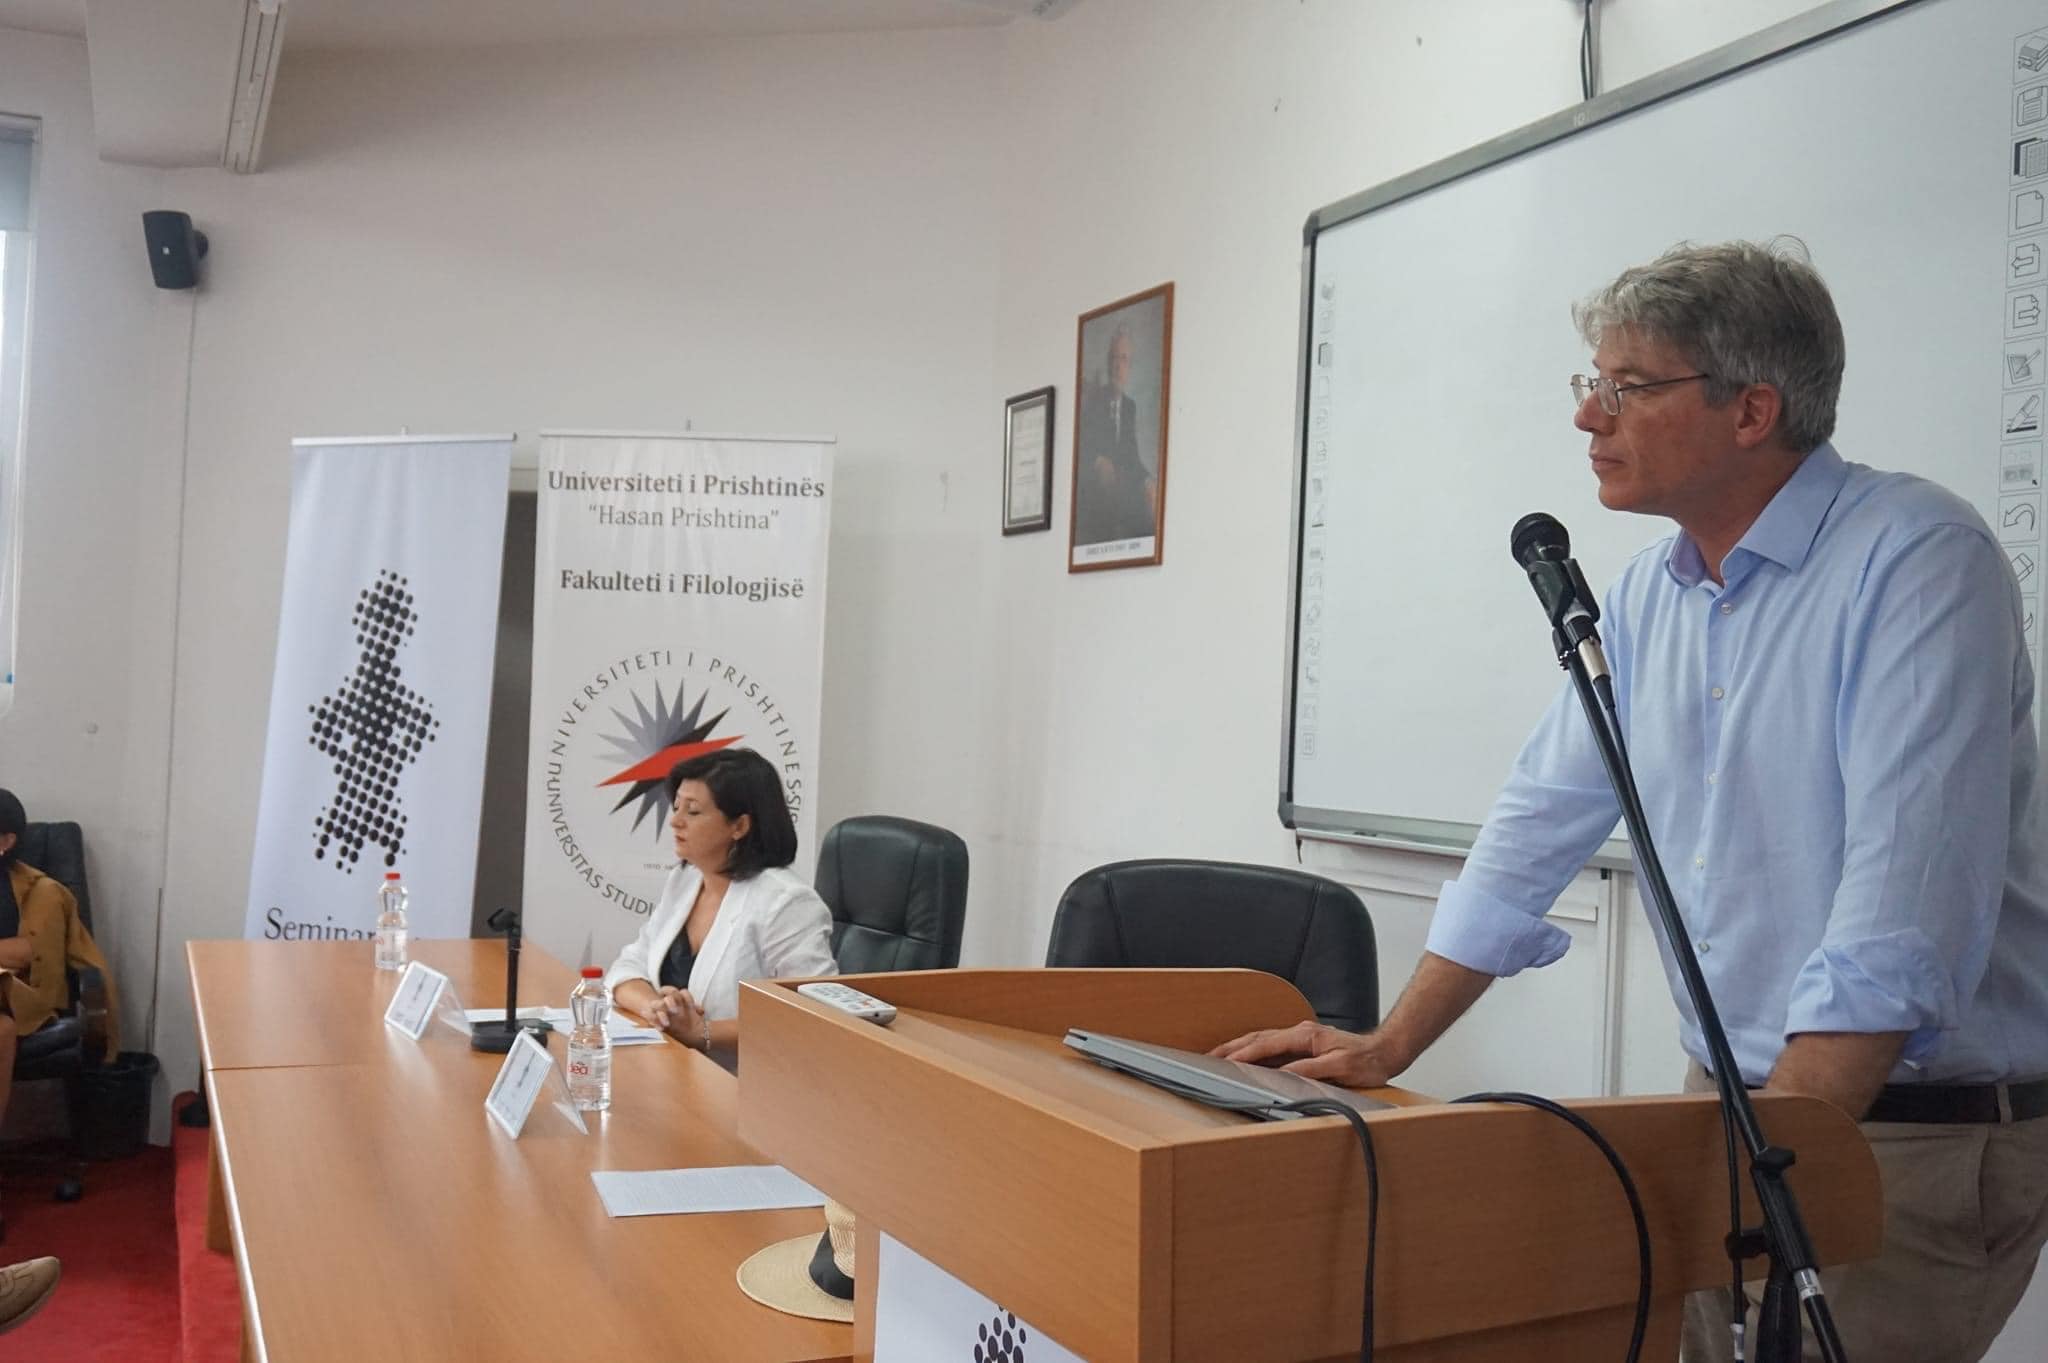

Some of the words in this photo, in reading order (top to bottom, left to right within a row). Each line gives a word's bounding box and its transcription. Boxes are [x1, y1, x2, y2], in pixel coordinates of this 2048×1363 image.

[548, 470, 682, 493] Universiteti
[690, 474, 696, 494] i
[703, 474, 826, 498] Prishtinës
[560, 569, 661, 593] Fakulteti
[669, 573, 674, 593] i
[681, 574, 804, 602] Filologjisë
[547, 650, 671, 775] UNIVERSITETI
[687, 651, 694, 667] I
[546, 778, 604, 889] UNIVERSITAS
[601, 883, 655, 917] STUDI
